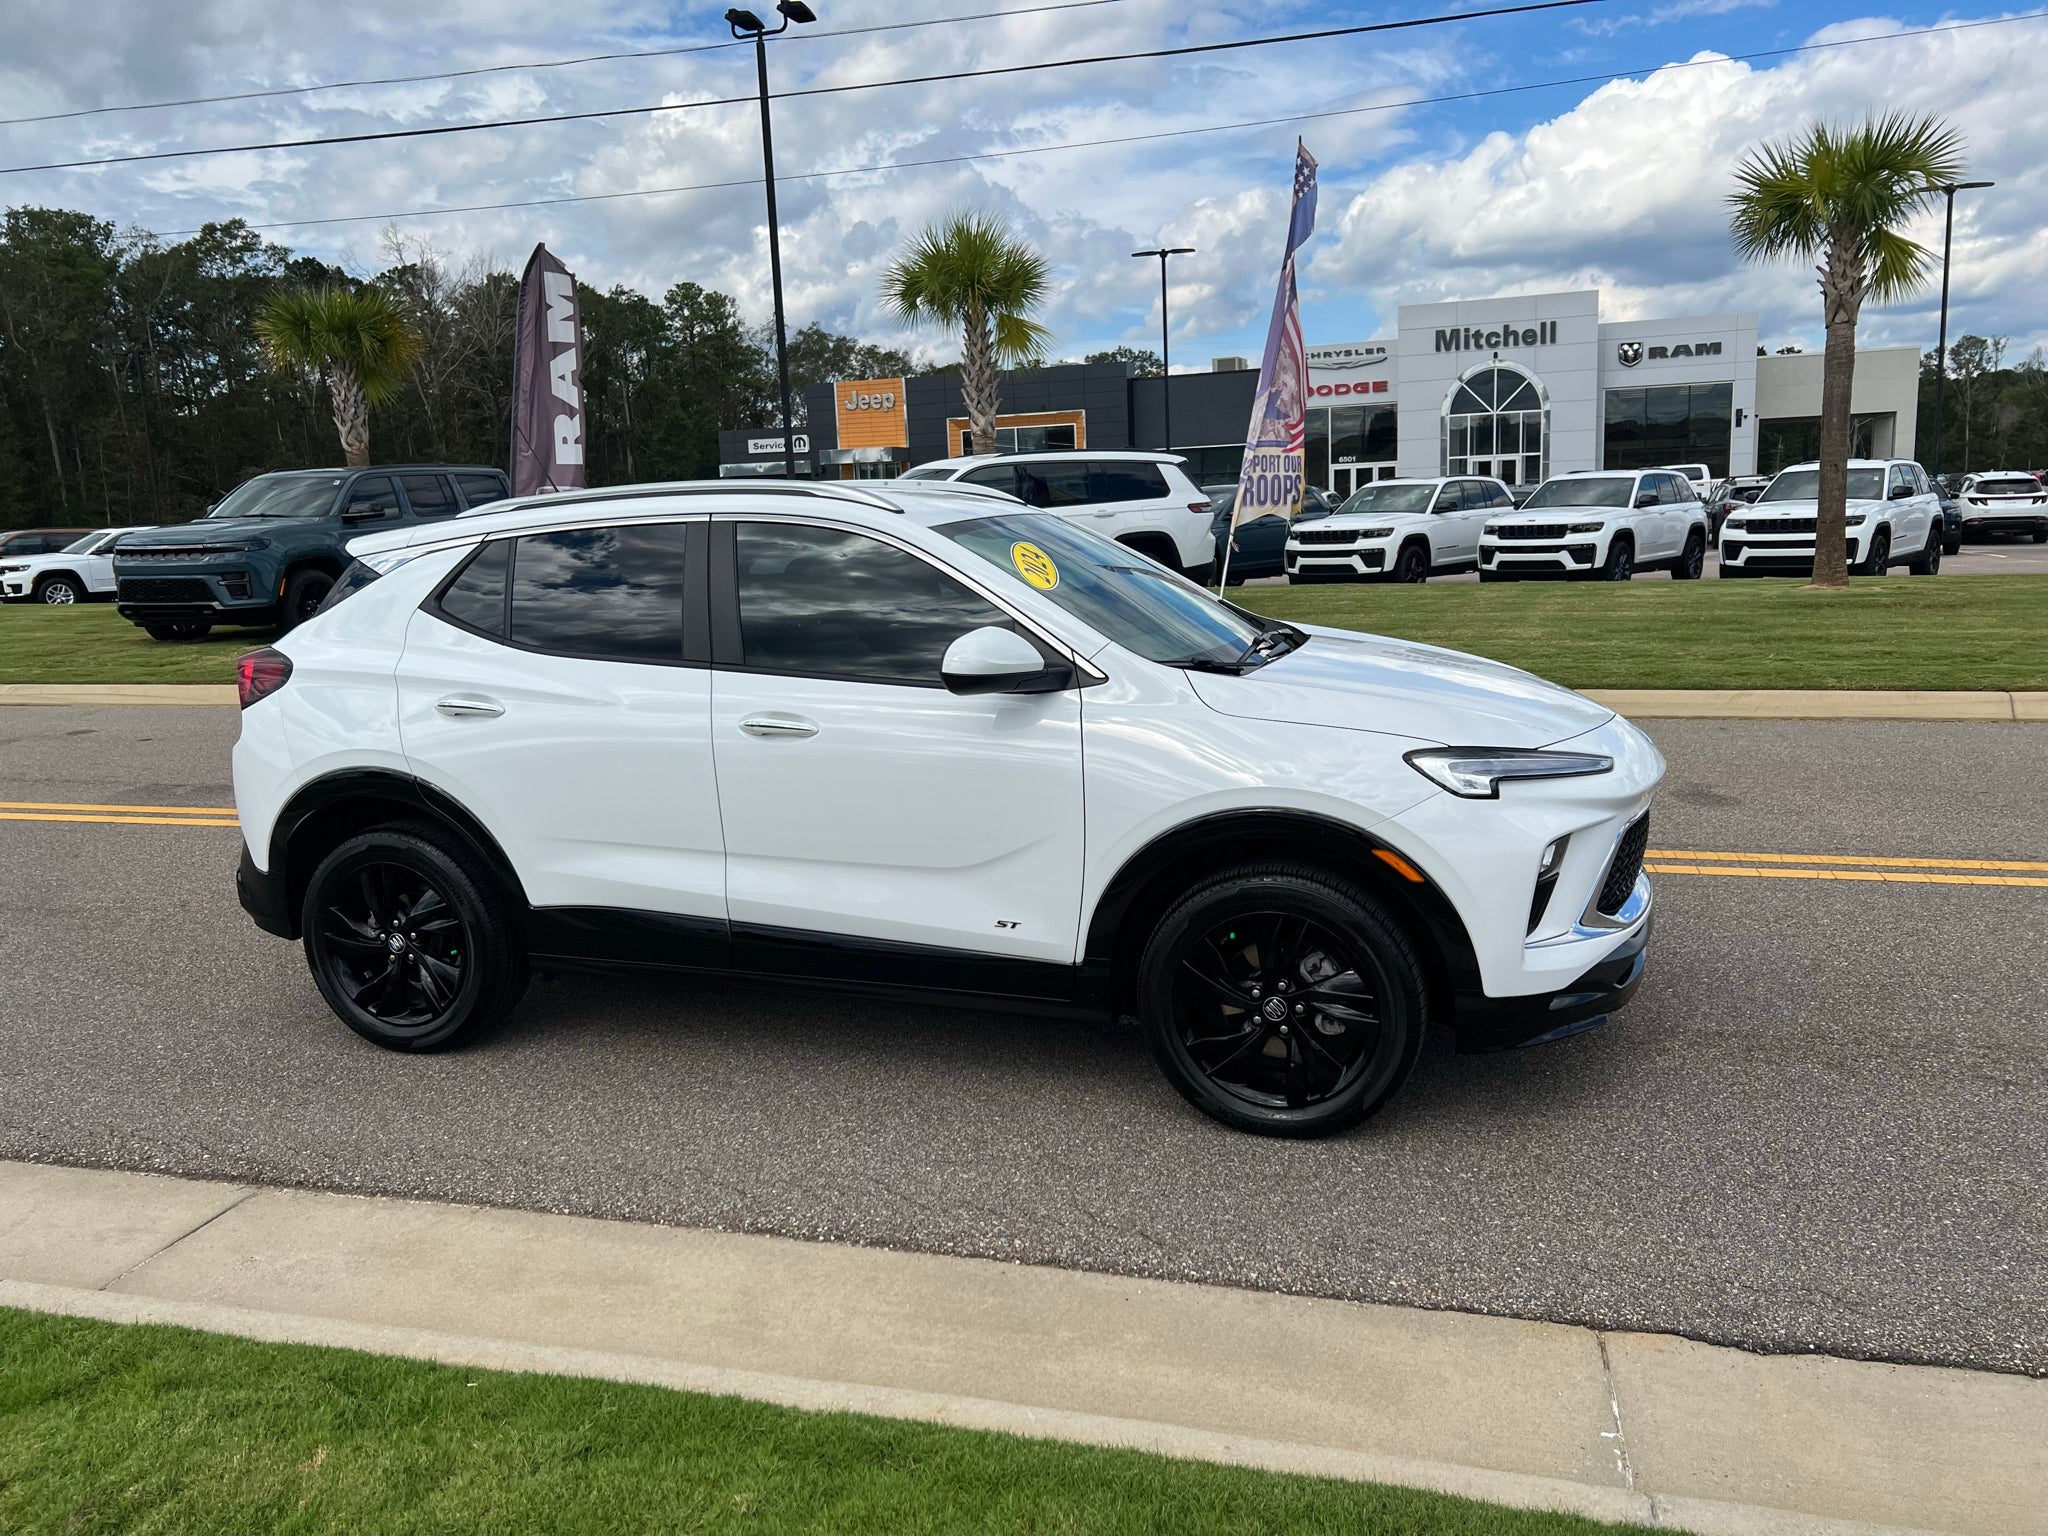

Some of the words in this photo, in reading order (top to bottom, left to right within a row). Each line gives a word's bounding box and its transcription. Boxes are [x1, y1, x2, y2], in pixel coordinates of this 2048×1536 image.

[1435, 320, 1557, 353] Mitchell
[1648, 341, 1723, 360] RAM
[544, 271, 584, 465] RAM
[844, 390, 896, 413] Jeep
[753, 441, 786, 450] Servic
[1283, 454, 1302, 473] OUR
[1242, 474, 1302, 506] ROOPS
[994, 920, 1022, 929] ST
